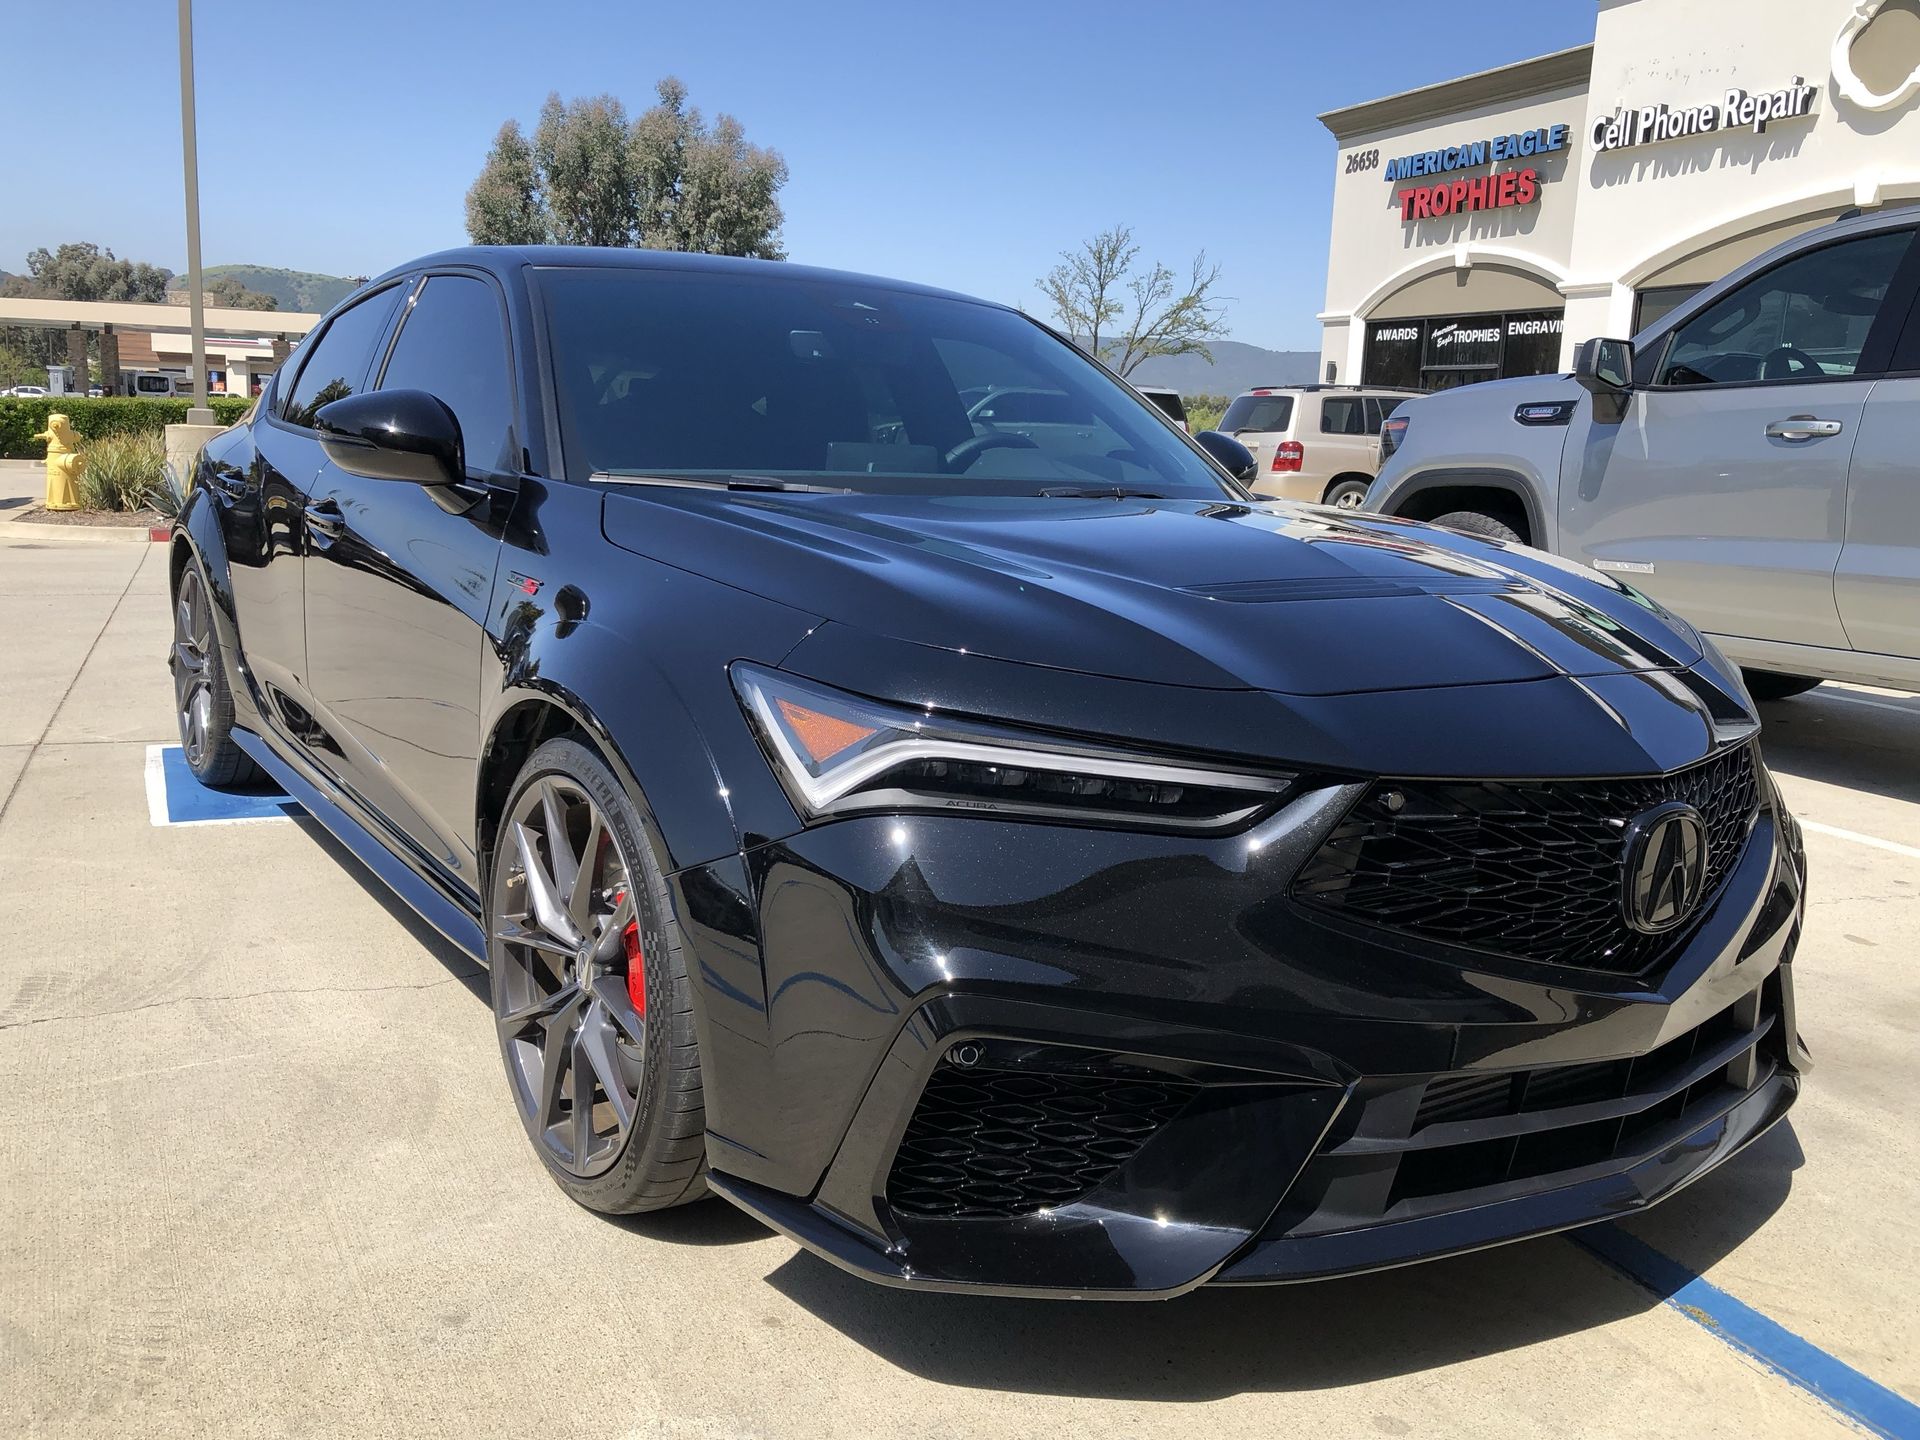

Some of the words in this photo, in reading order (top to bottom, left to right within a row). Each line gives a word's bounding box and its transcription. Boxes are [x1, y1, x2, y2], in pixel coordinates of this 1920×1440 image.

[1590, 110, 1636, 152] Cell
[1636, 103, 1718, 143] Phone
[1722, 75, 1815, 133] Repair
[1384, 140, 1489, 182] AMERICAN
[1490, 123, 1568, 161] EAGLE
[1345, 149, 1380, 174] 26658
[1398, 168, 1536, 222] TROPHIES
[1376, 327, 1418, 341] AWARDS
[1431, 323, 1458, 340] American
[1453, 328, 1500, 344] TROPHIES
[1437, 334, 1453, 348] Eagle
[945, 800, 999, 810] ACURA
